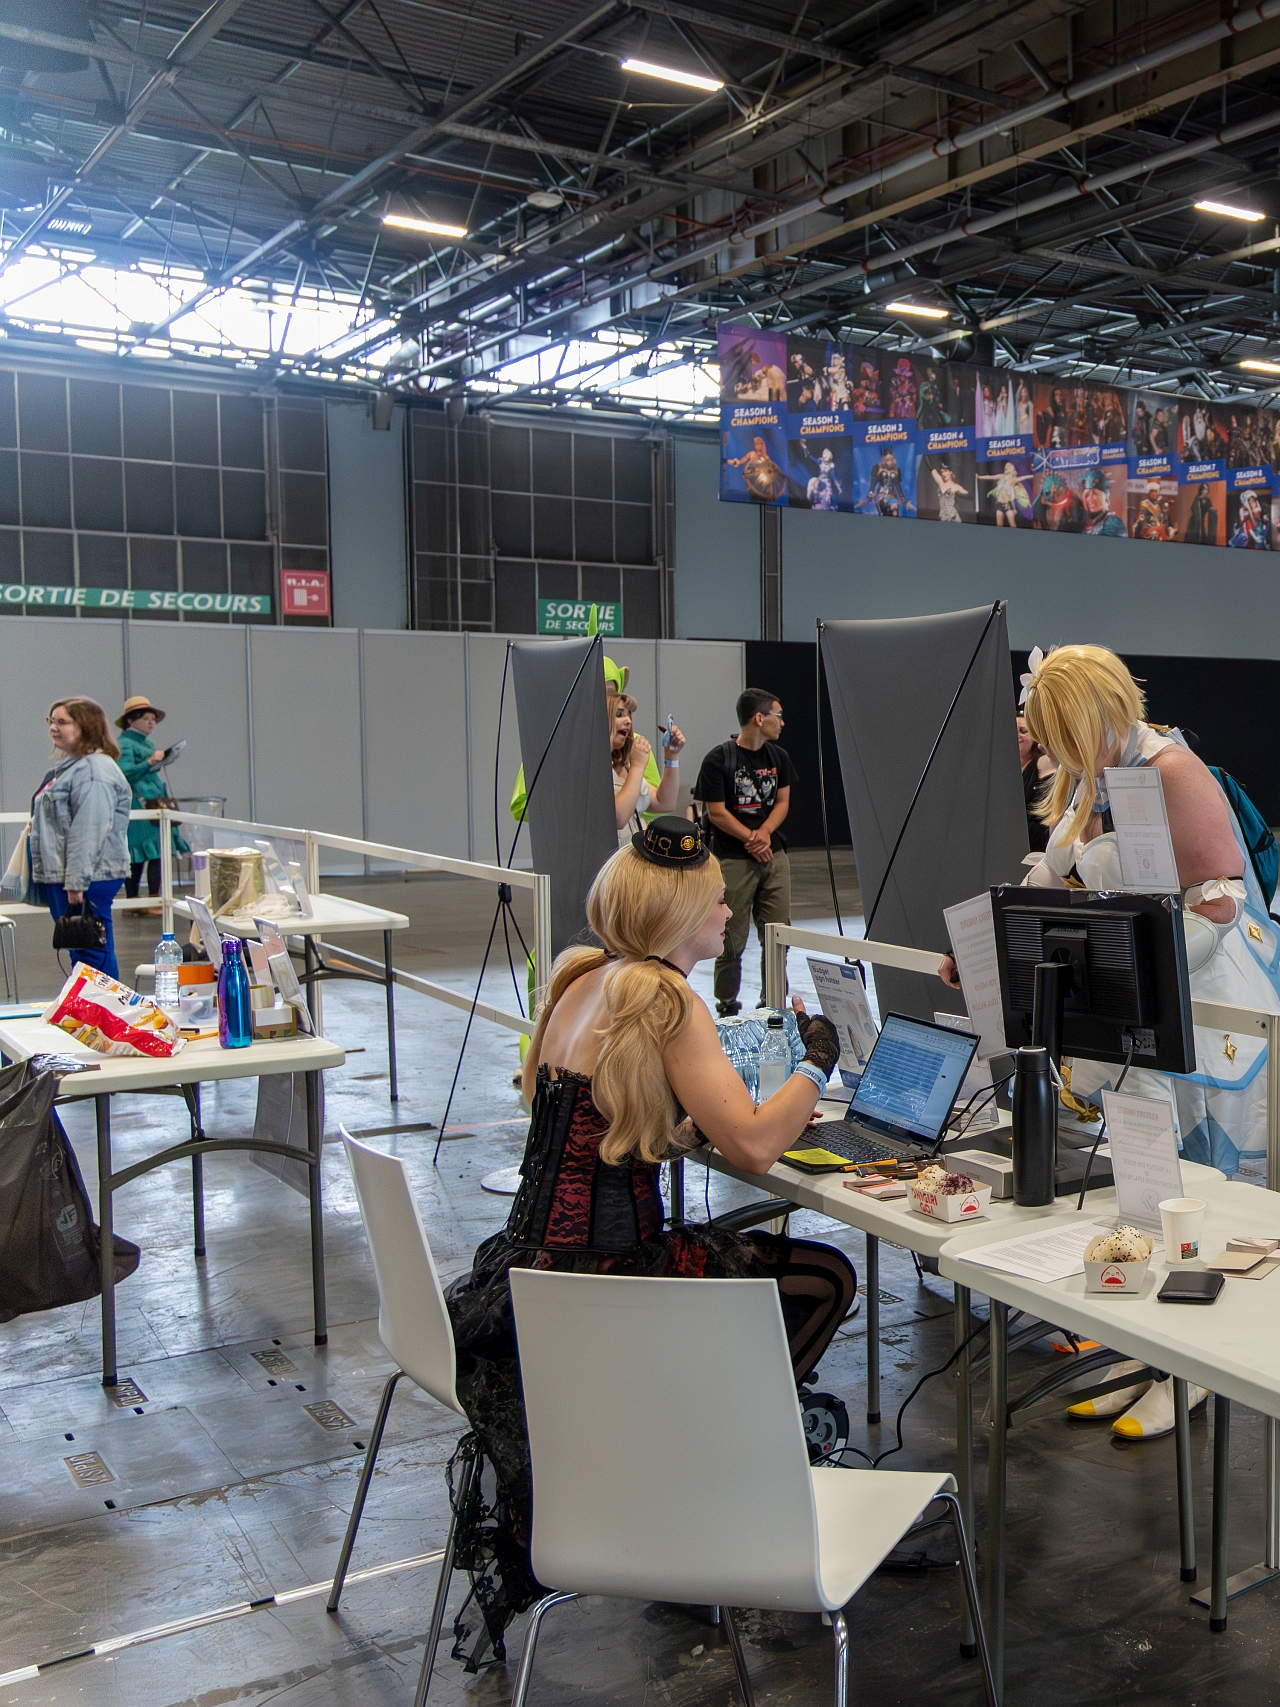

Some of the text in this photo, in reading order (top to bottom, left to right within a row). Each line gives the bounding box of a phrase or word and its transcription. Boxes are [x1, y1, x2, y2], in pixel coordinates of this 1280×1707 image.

[734, 407, 772, 417] SEASON 1
[731, 415, 778, 427] CHAMPIONS
[802, 415, 839, 426] SEASON 2
[800, 423, 845, 435] CHAMPIONS
[868, 423, 903, 434] SEASON 3
[865, 431, 908, 443] CHAMPIONS
[930, 431, 964, 442] SEASON 4
[927, 439, 968, 450] CHAMPIONS
[989, 438, 1021, 449] SEASON 5
[986, 446, 1026, 457] CHAMPIONS
[1138, 458, 1162, 468] SEASON
[1136, 465, 1171, 475] CHAMPIONS
[1188, 464, 1211, 474] SEASON
[1236, 470, 1256, 479] SEASON
[1186, 471, 1220, 481] CHAMPIONS
[1234, 476, 1266, 487] CHAMPIONS
[0, 584, 262, 613] ORTIE DE SECOURS
[545, 620, 561, 629] DE
